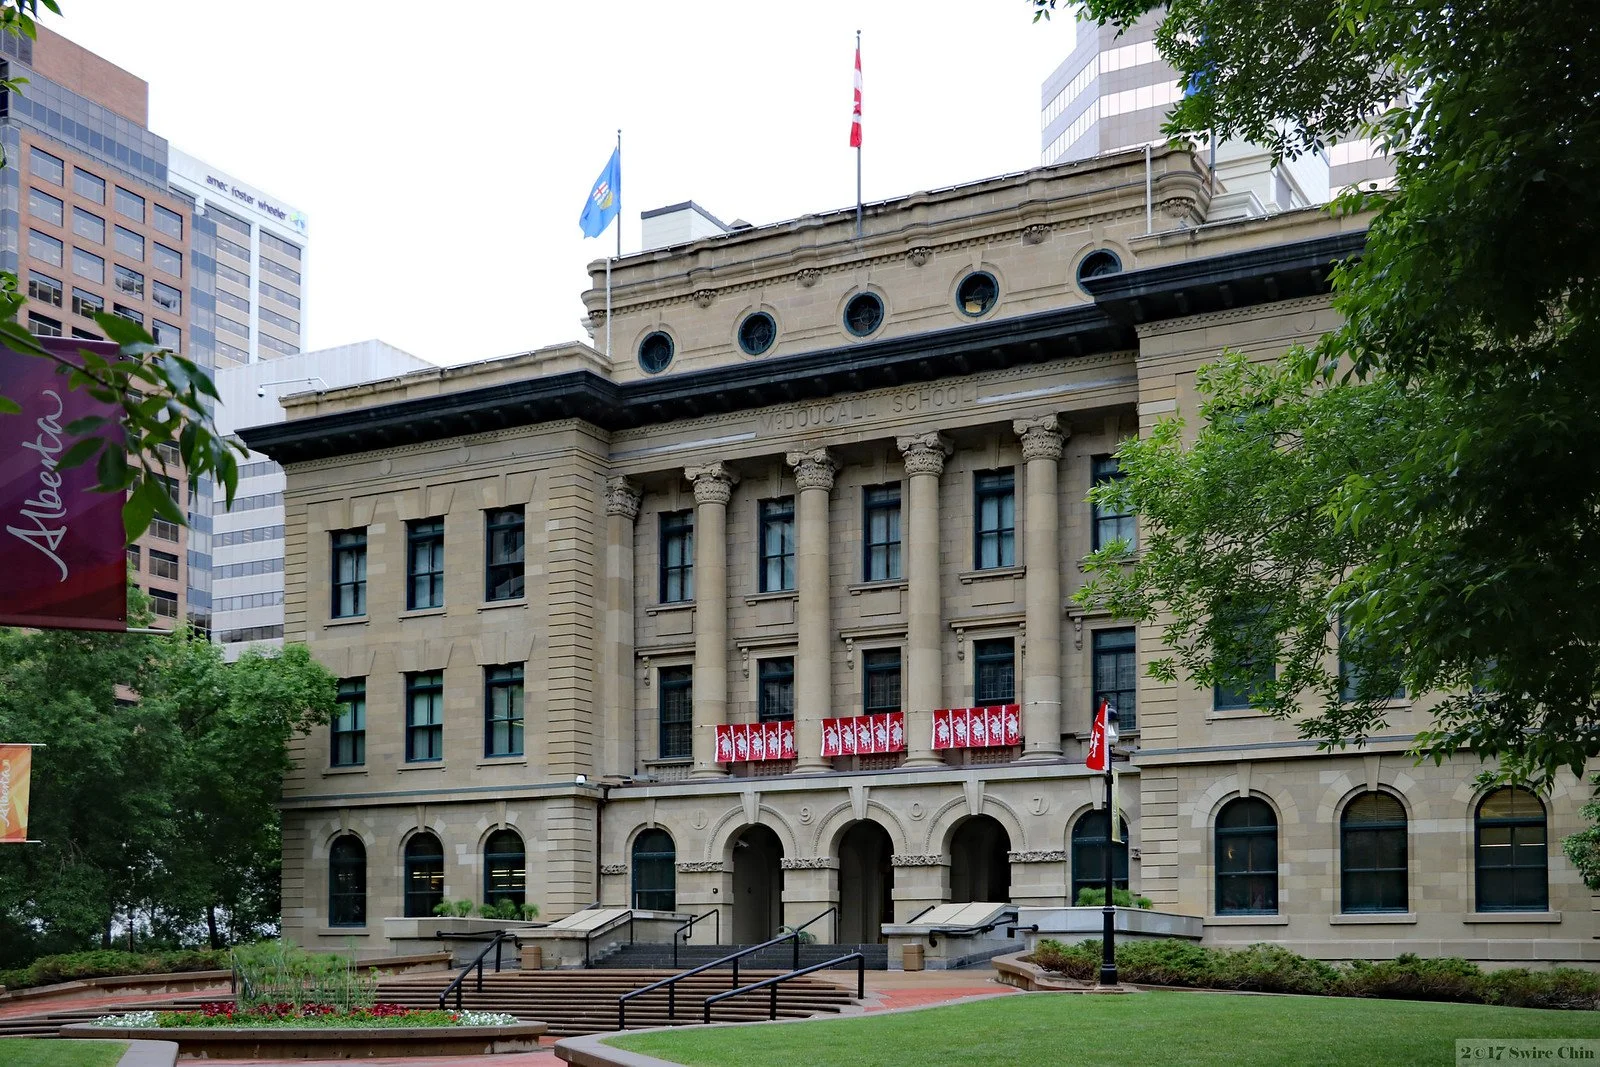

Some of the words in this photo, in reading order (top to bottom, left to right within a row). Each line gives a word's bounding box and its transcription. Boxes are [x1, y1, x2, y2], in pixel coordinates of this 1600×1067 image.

[206, 175, 228, 192] amec
[231, 186, 255, 205] foster
[258, 200, 287, 220] wheeler
[893, 384, 973, 412] SCHOOL
[6, 389, 68, 583] Alberta
